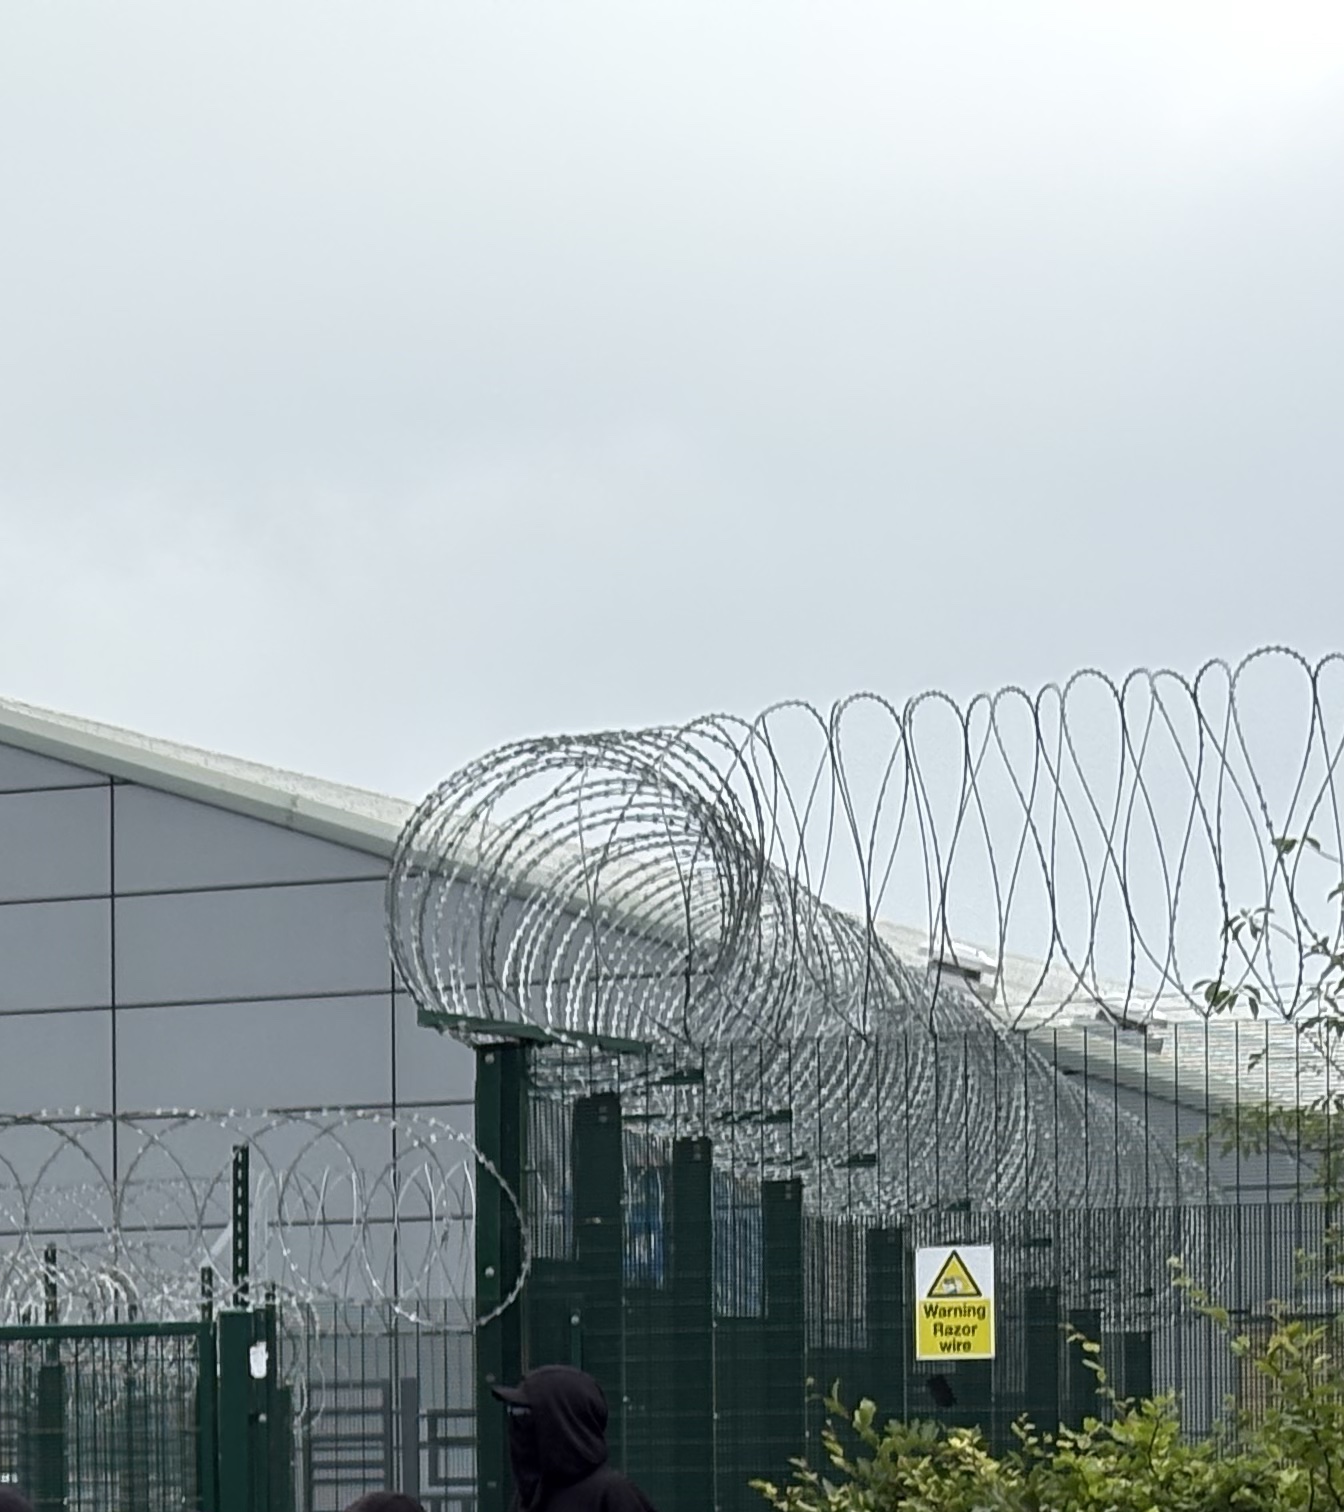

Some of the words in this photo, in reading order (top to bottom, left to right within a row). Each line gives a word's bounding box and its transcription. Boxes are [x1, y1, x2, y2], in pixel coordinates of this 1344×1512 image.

[923, 1303, 986, 1321] Warning
[933, 1321, 978, 1337] Razor
[939, 1338, 972, 1353] wire
